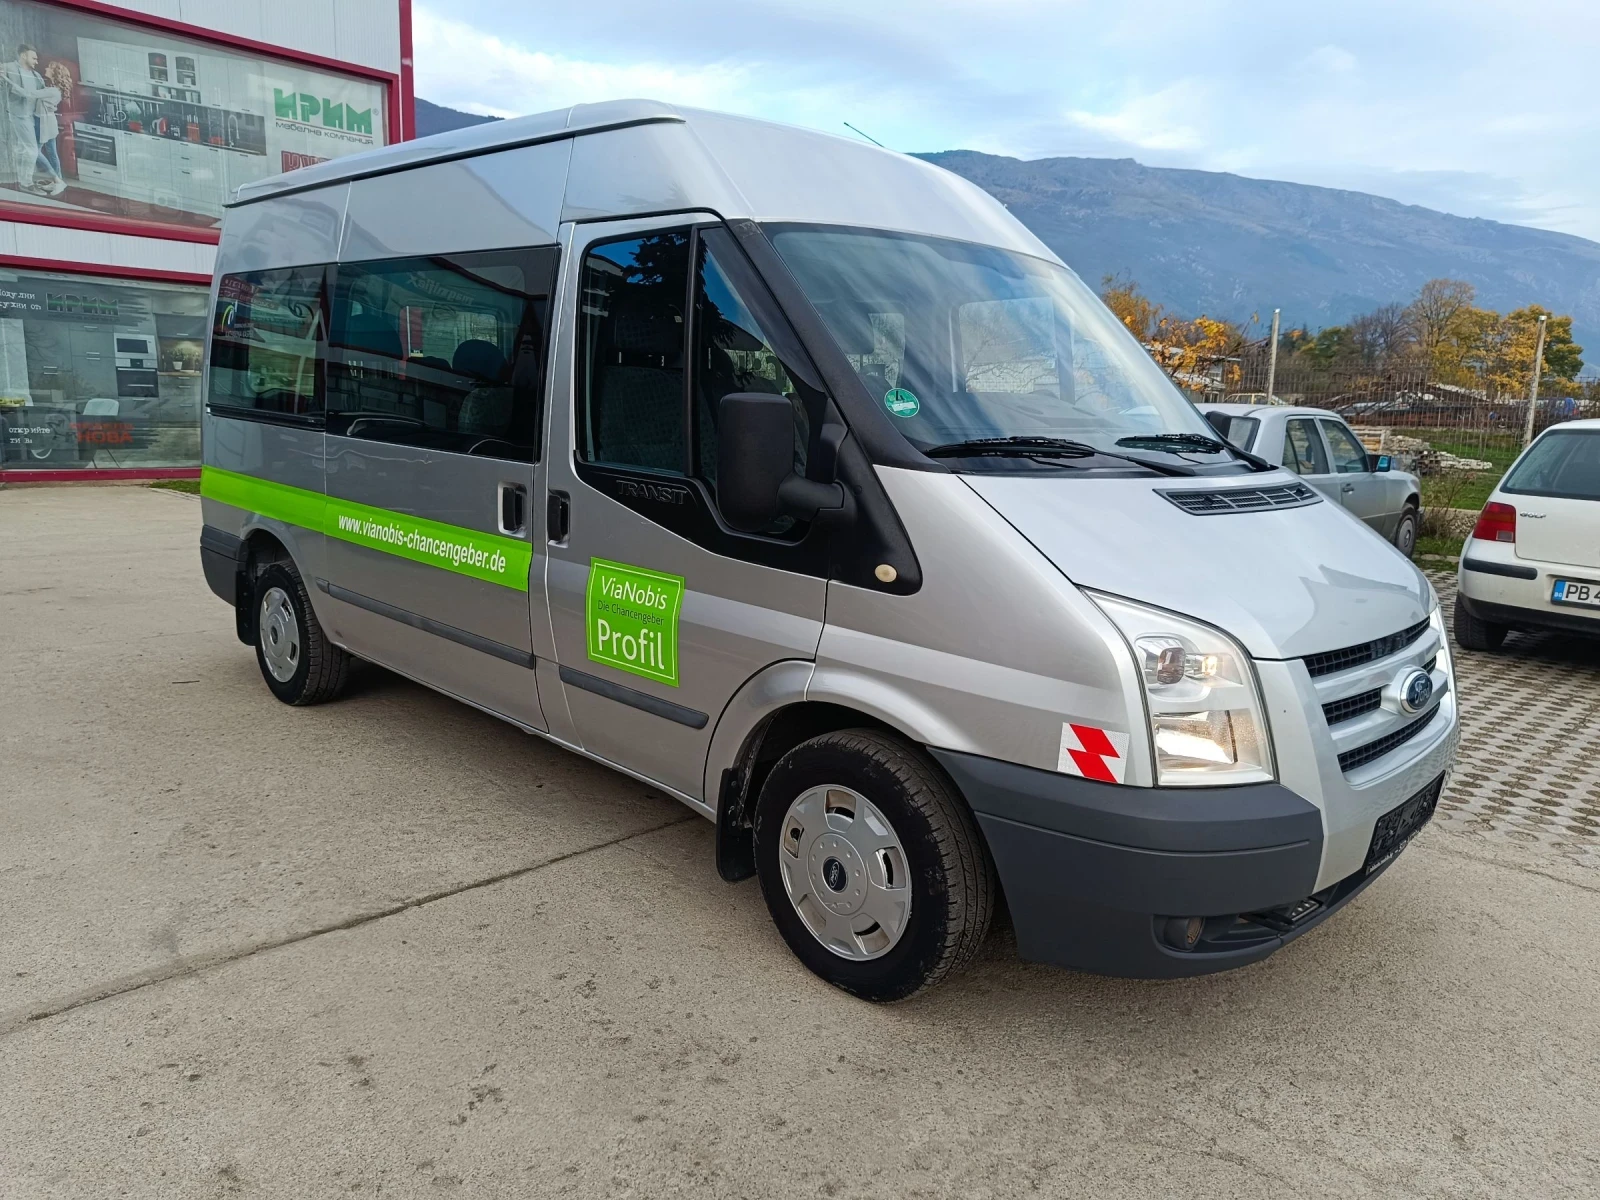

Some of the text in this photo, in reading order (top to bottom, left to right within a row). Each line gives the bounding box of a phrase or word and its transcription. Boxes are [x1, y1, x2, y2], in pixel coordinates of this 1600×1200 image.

[274, 87, 372, 135] ИРИМ
[275, 121, 374, 145] мебелна компания
[615, 479, 688, 505] TRANSIT
[1519, 511, 1547, 519] GOLF
[338, 512, 506, 574] www.vianobis-chancengeber.de
[602, 575, 668, 610] ViaNobis
[597, 600, 665, 626] Die Chancengeber
[597, 618, 665, 670] Profil
[1414, 678, 1430, 704] Ford
